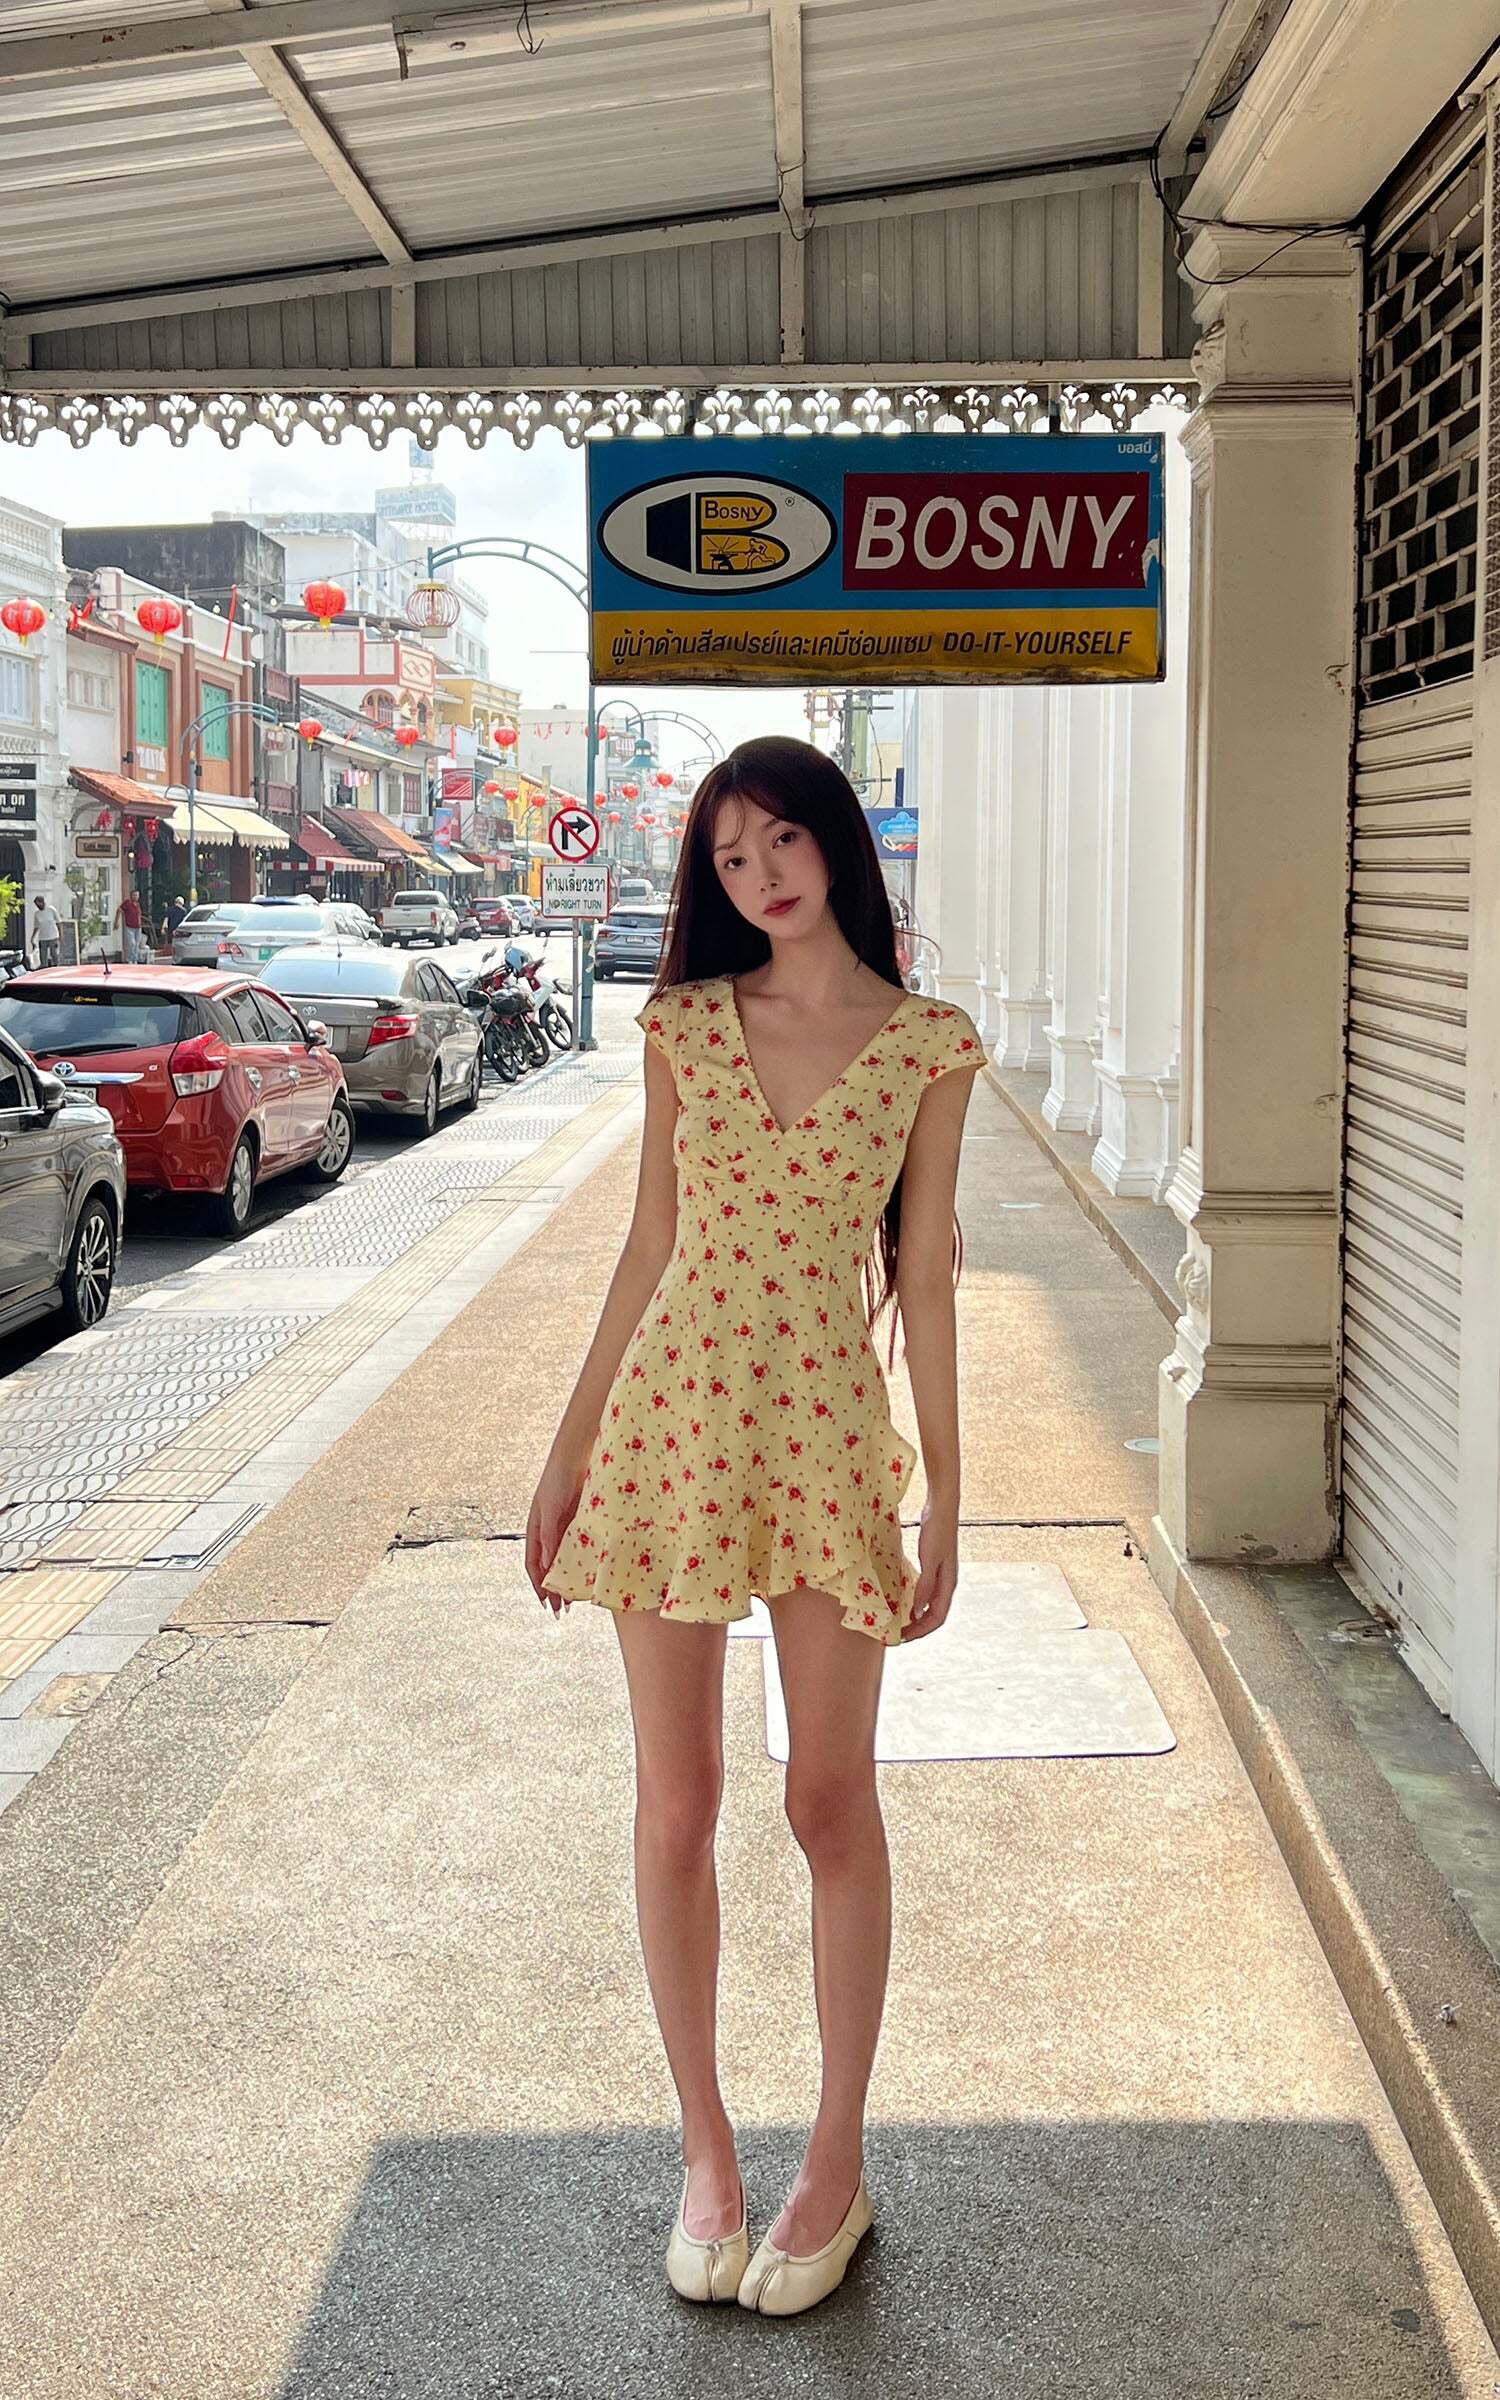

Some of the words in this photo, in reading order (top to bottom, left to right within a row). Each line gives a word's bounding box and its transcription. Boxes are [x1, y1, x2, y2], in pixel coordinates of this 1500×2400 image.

[855, 495, 1135, 570] BOSNY
[611, 628, 933, 665] ผู้นำด้านสีสเปรย์และเคมีซ่อมแซม
[943, 631, 1132, 654] DO-IT-YOURSELF
[546, 868, 605, 891] ห้ามเลี้ยวขวา
[548, 899, 560, 909] NO
[561, 899, 580, 909] RIGHT
[583, 899, 602, 909] TURN
